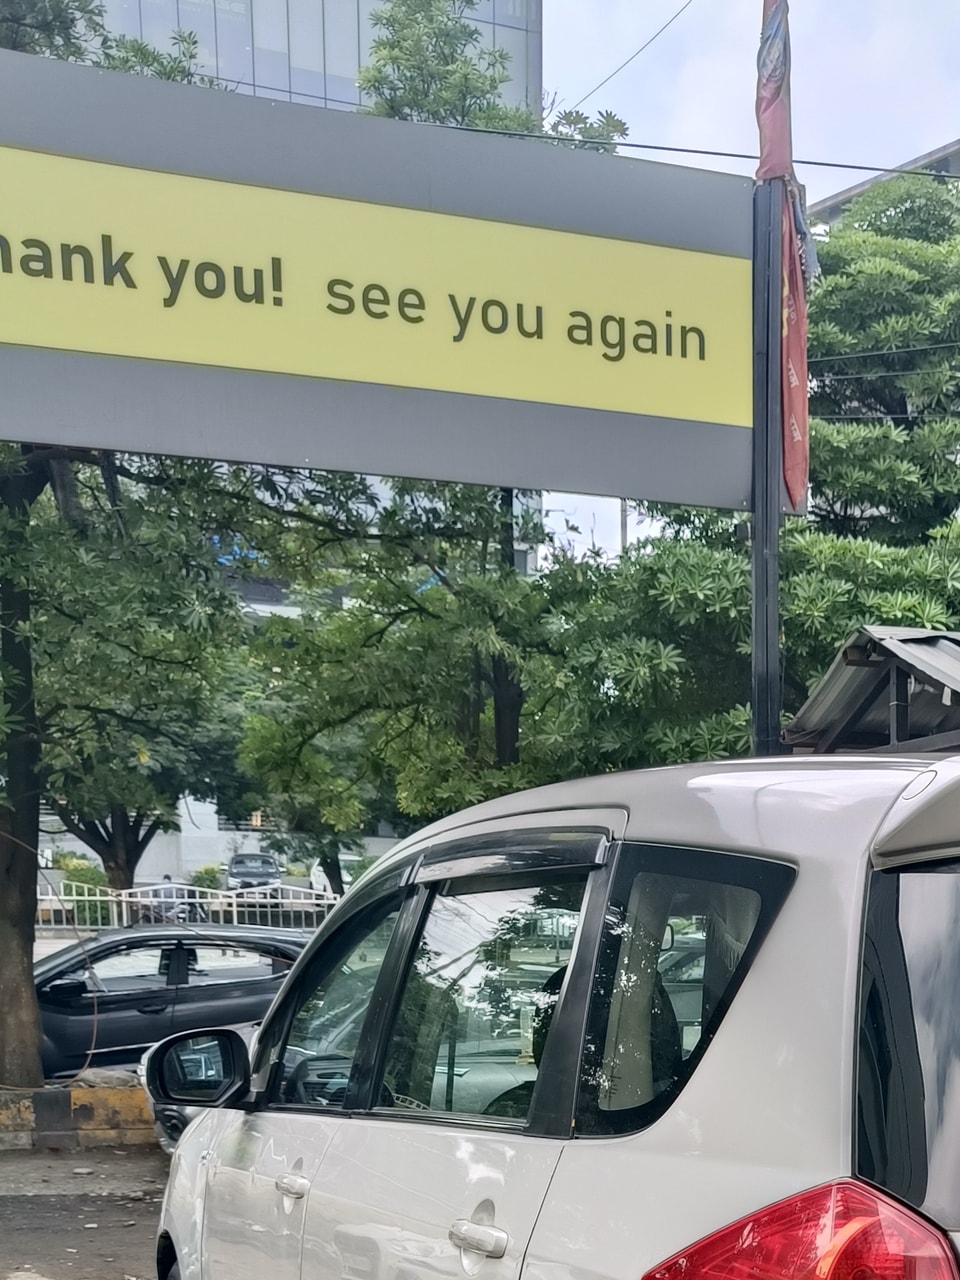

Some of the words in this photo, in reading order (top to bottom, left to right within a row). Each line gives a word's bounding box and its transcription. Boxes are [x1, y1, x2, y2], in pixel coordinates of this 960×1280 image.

[156, 255, 284, 308] you!
[326, 278, 426, 324] see
[448, 293, 544, 342] you
[567, 310, 706, 362] again
